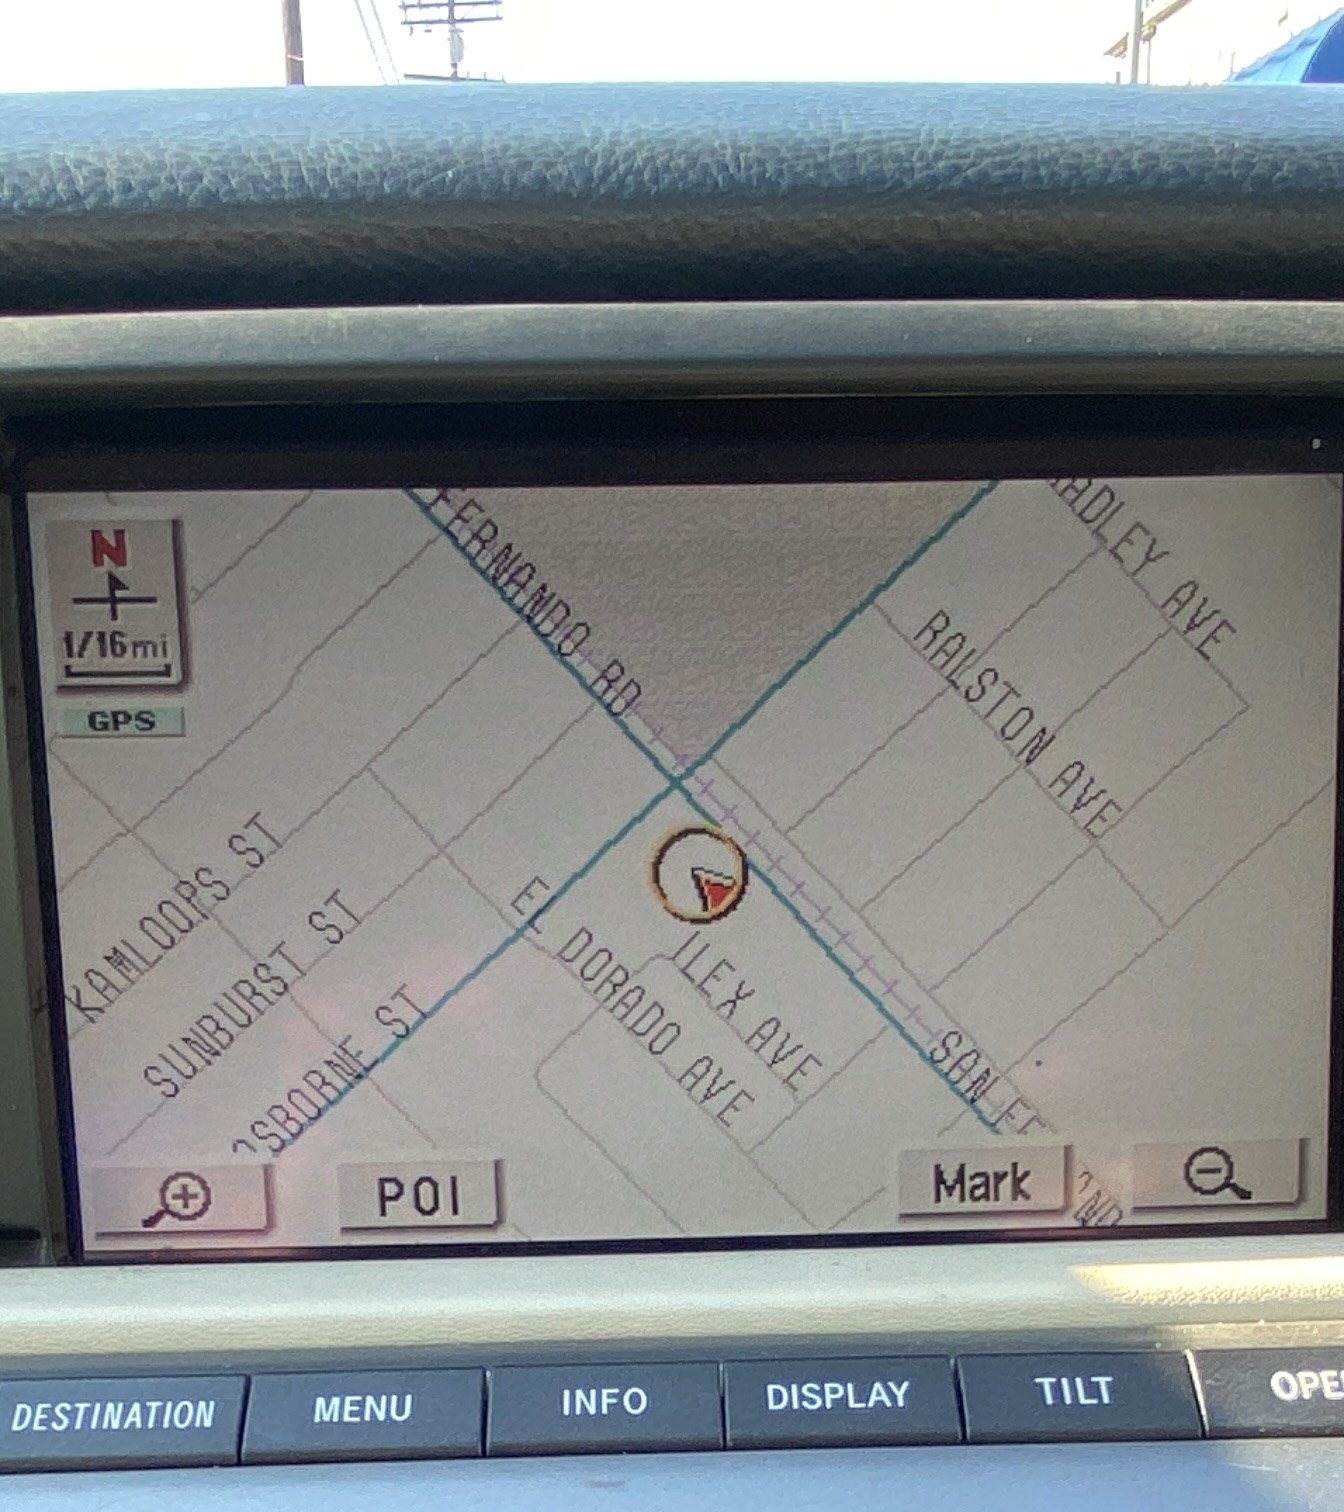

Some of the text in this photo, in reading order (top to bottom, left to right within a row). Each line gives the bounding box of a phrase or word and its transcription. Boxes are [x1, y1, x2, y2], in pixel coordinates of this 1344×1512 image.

[91, 529, 127, 567] N
[1161, 580, 1236, 661] AVE
[591, 660, 641, 716] RD
[87, 710, 156, 731] GPS
[913, 610, 1122, 839] RALSTON AVE
[67, 812, 283, 1023] KAMLOOPS ST
[144, 888, 361, 1098] SUNBURST ST
[375, 983, 427, 1039] ST
[510, 875, 755, 1128] EL DORADO AVE
[669, 930, 823, 1092] ILEX AVE
[930, 1031, 1000, 1105] SAN
[377, 1174, 459, 1218] POI
[934, 1161, 1032, 1204] Mark
[312, 1394, 413, 1424] MENU
[562, 1386, 649, 1417] INFO
[766, 1380, 911, 1412] DISPLAY
[1034, 1375, 1115, 1406] TILT
[11, 1400, 216, 1433] DESTINATION
